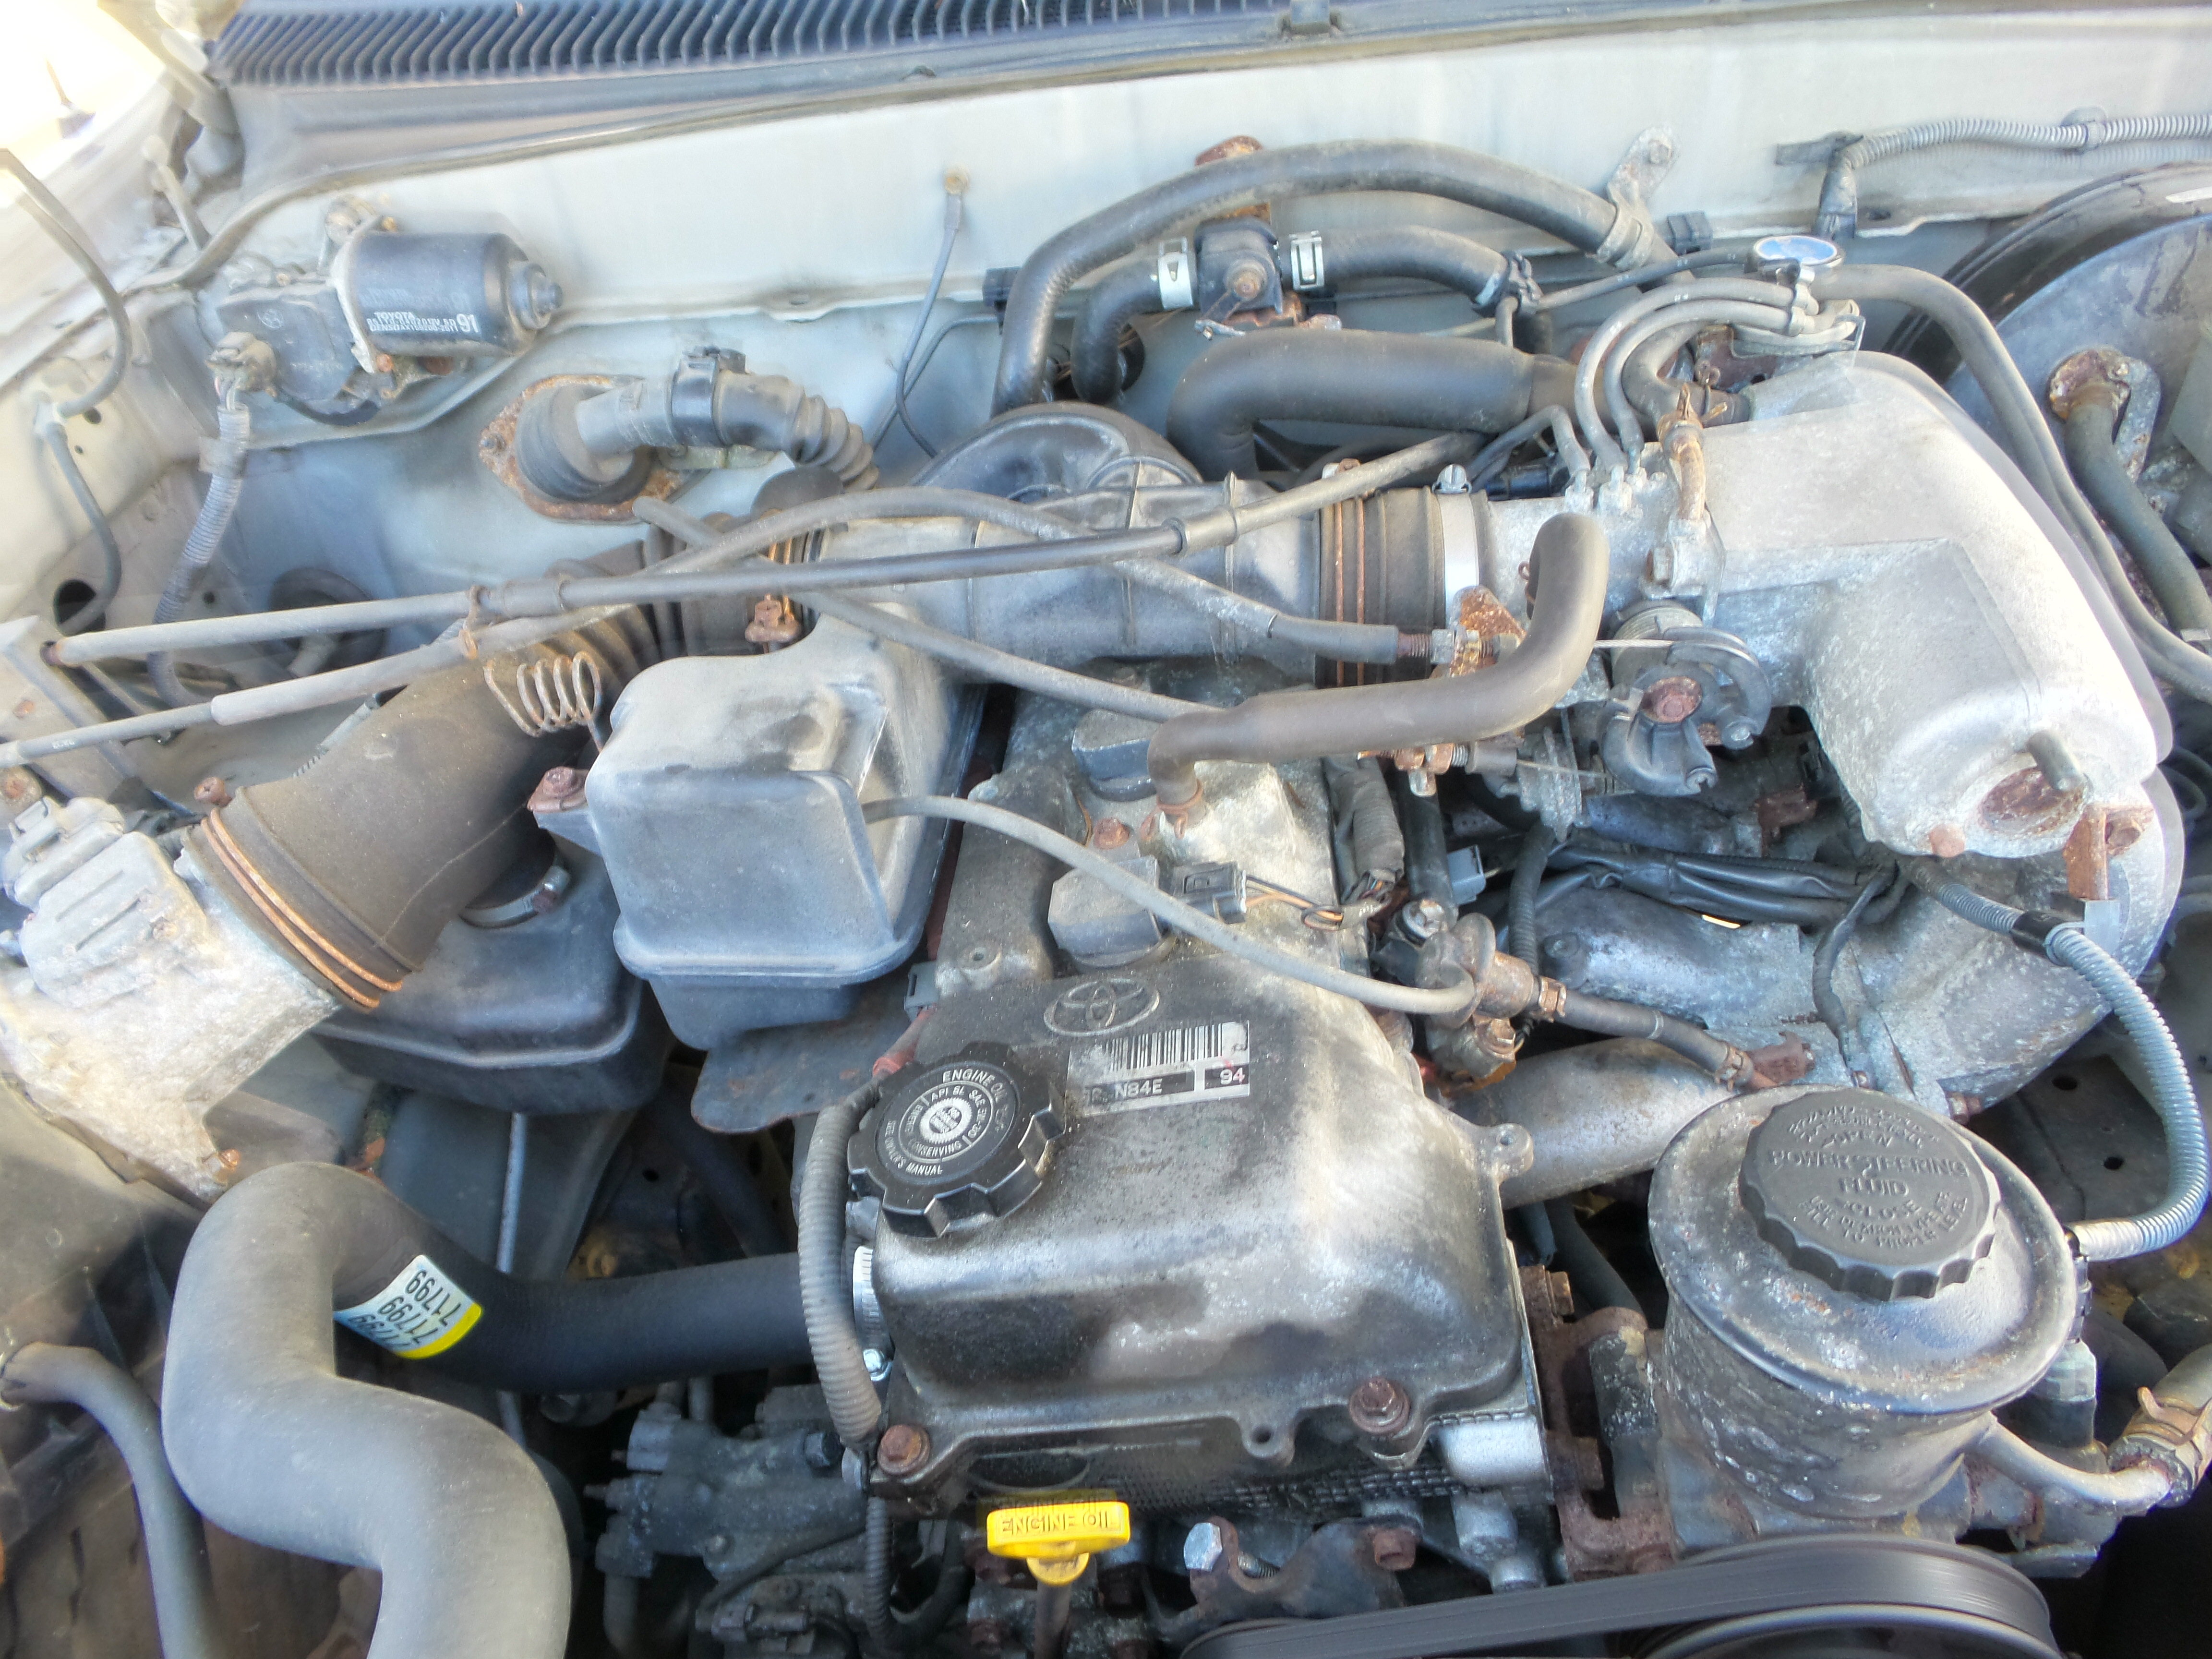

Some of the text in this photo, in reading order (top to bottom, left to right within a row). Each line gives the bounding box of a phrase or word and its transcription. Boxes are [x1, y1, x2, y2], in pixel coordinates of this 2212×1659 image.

[374, 312, 416, 320] TOYOTA
[457, 313, 479, 333] 91
[943, 1069, 995, 1086] ENGINE
[1220, 1067, 1246, 1085] 94
[932, 1087, 949, 1102] API
[969, 1090, 986, 1108] SAE
[1114, 1078, 1163, 1099] N84E
[905, 1162, 943, 1176] MANUAL
[405, 1270, 461, 1326] 71799
[378, 1296, 439, 1344] 71799
[1001, 1510, 1119, 1535] ENGINE OIL
